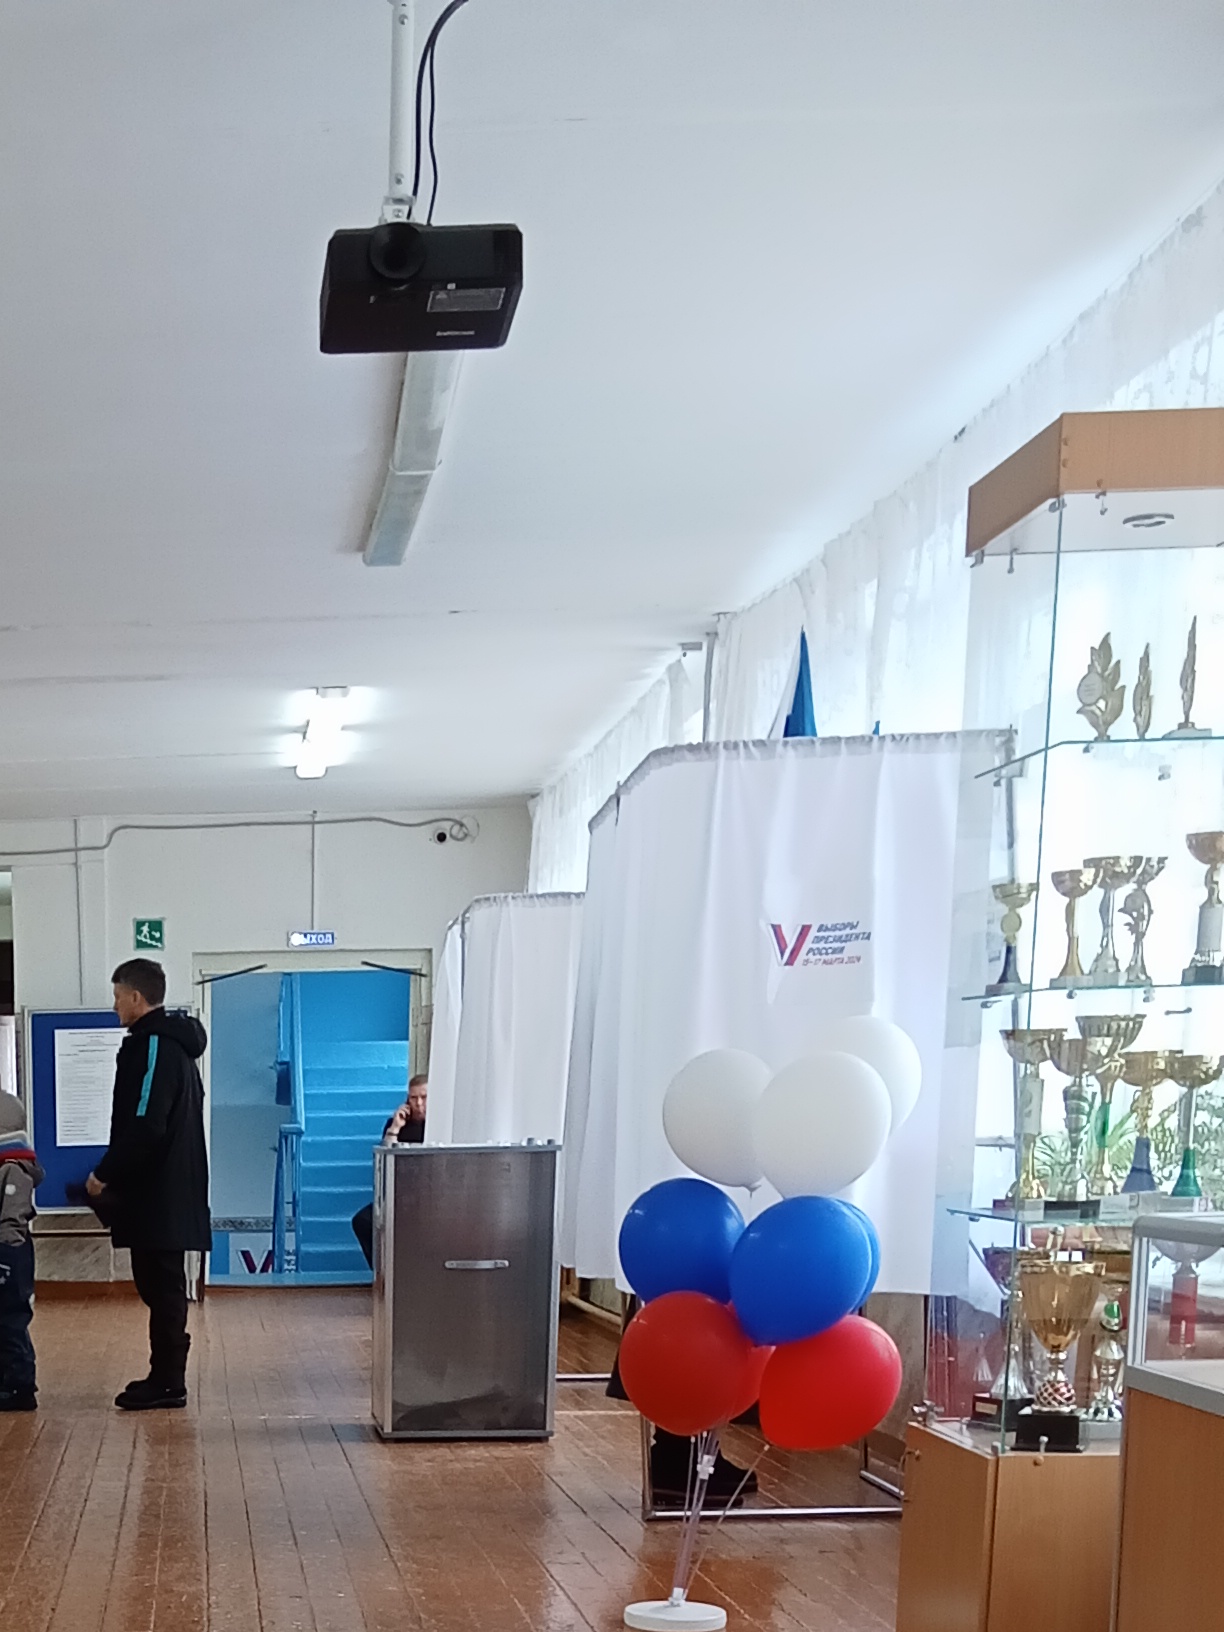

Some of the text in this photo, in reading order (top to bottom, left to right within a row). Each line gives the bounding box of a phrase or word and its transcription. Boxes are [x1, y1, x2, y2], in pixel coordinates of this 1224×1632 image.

[816, 920, 859, 933] ВЫБОРЫ
[294, 933, 333, 944] ЫХОД
[811, 931, 872, 944] ПРЕЗИДЕНТА
[806, 946, 845, 956] РОССИИ
